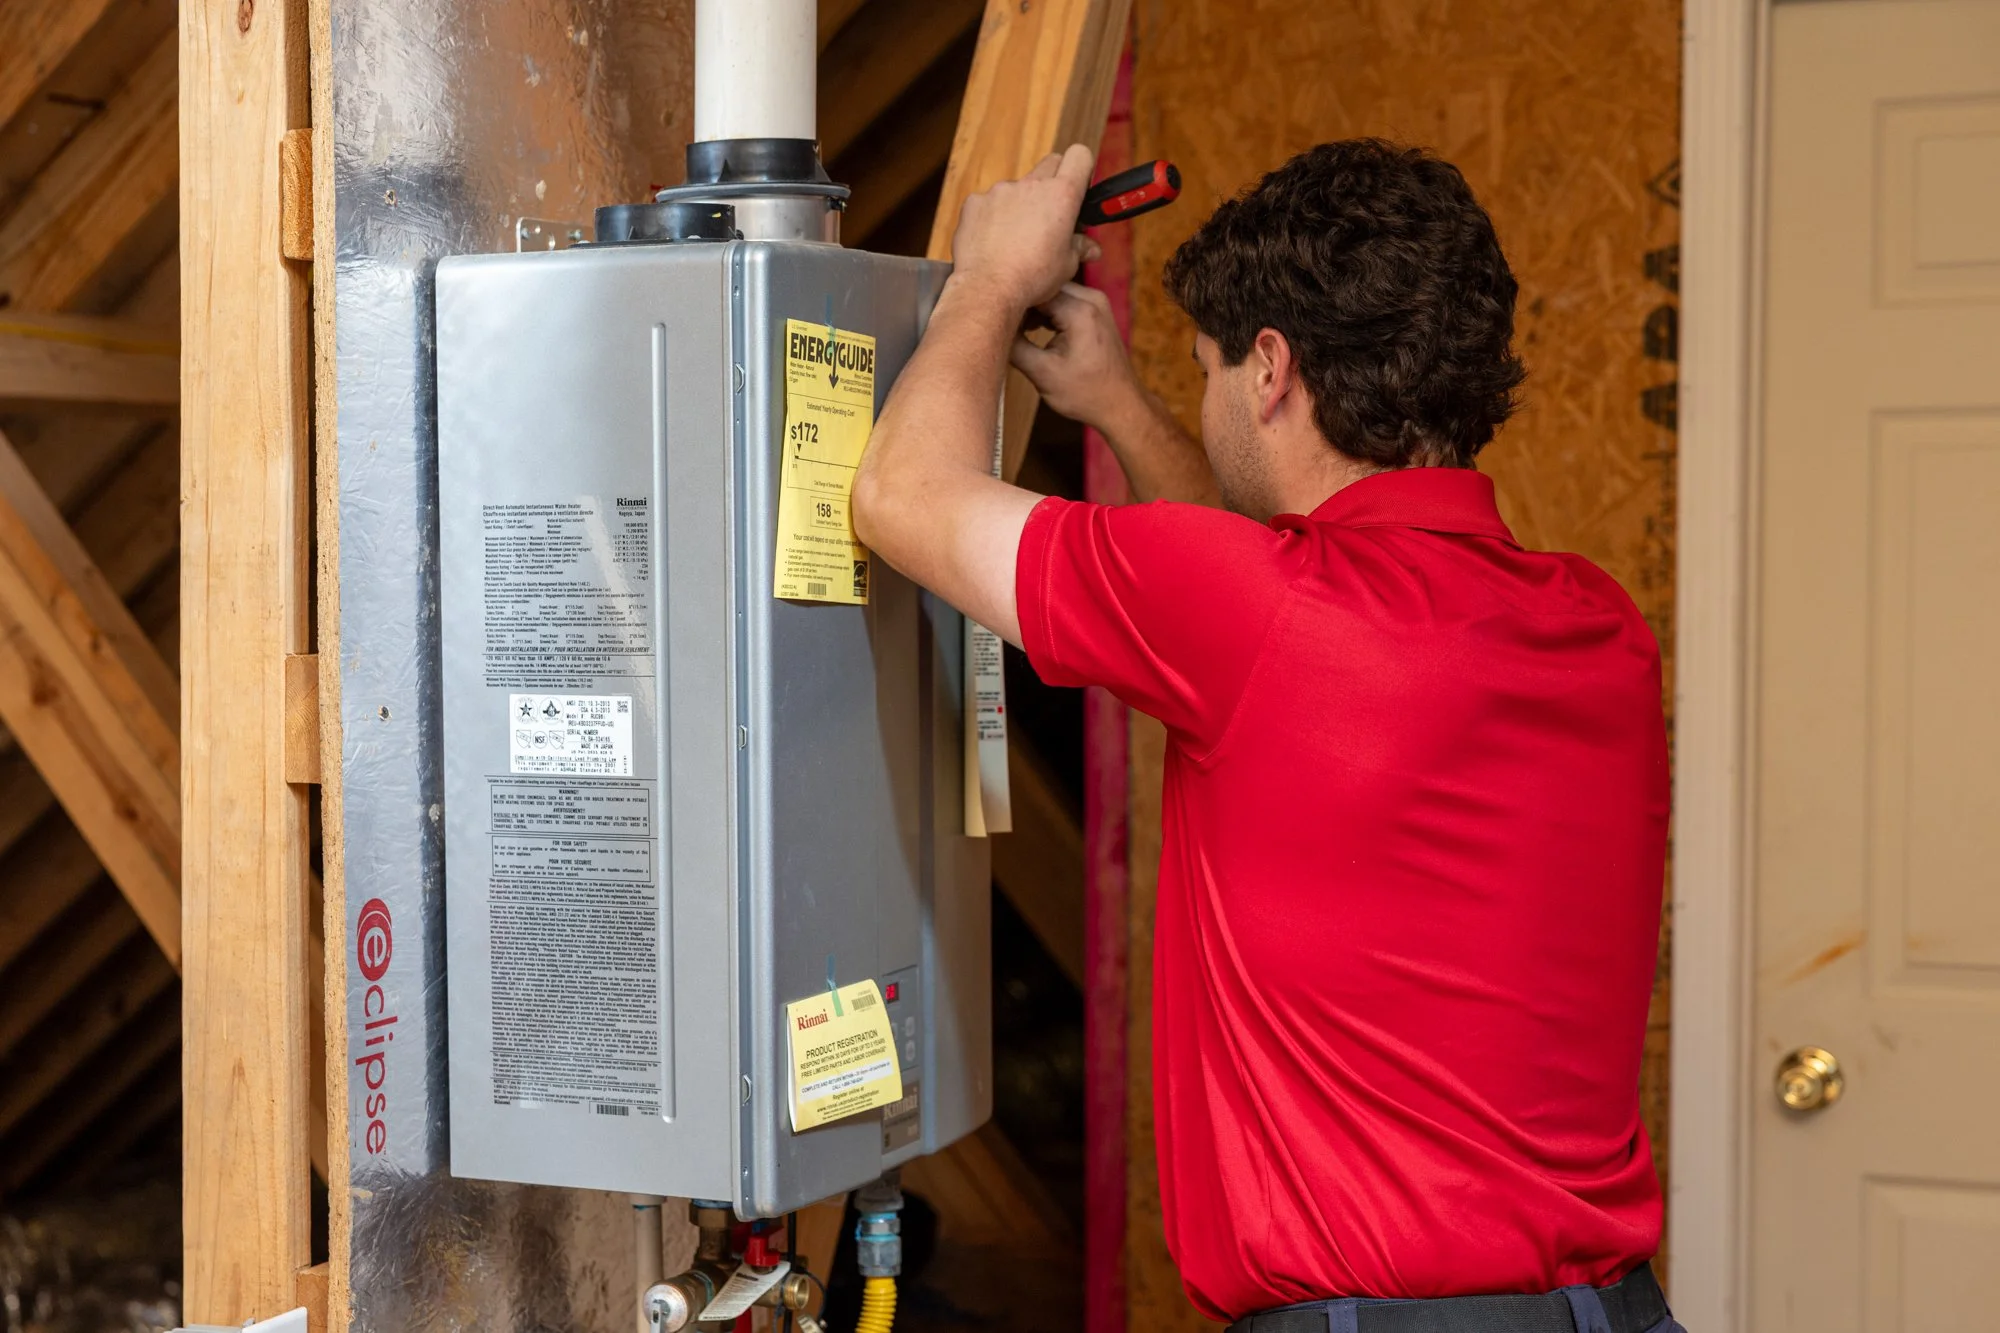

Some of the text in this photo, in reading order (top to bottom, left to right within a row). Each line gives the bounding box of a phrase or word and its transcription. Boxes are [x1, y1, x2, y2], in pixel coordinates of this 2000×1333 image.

[790, 332, 875, 375] ENERGYGUIDE
[791, 421, 819, 443] $172
[616, 498, 647, 506] Rinnai
[816, 502, 832, 518] 158
[356, 898, 398, 1155] eclipse
[797, 1009, 829, 1031] Rinnai
[806, 1029, 879, 1060] PRODUCT REGISTRATION
[800, 1058, 821, 1071] RESPOND
